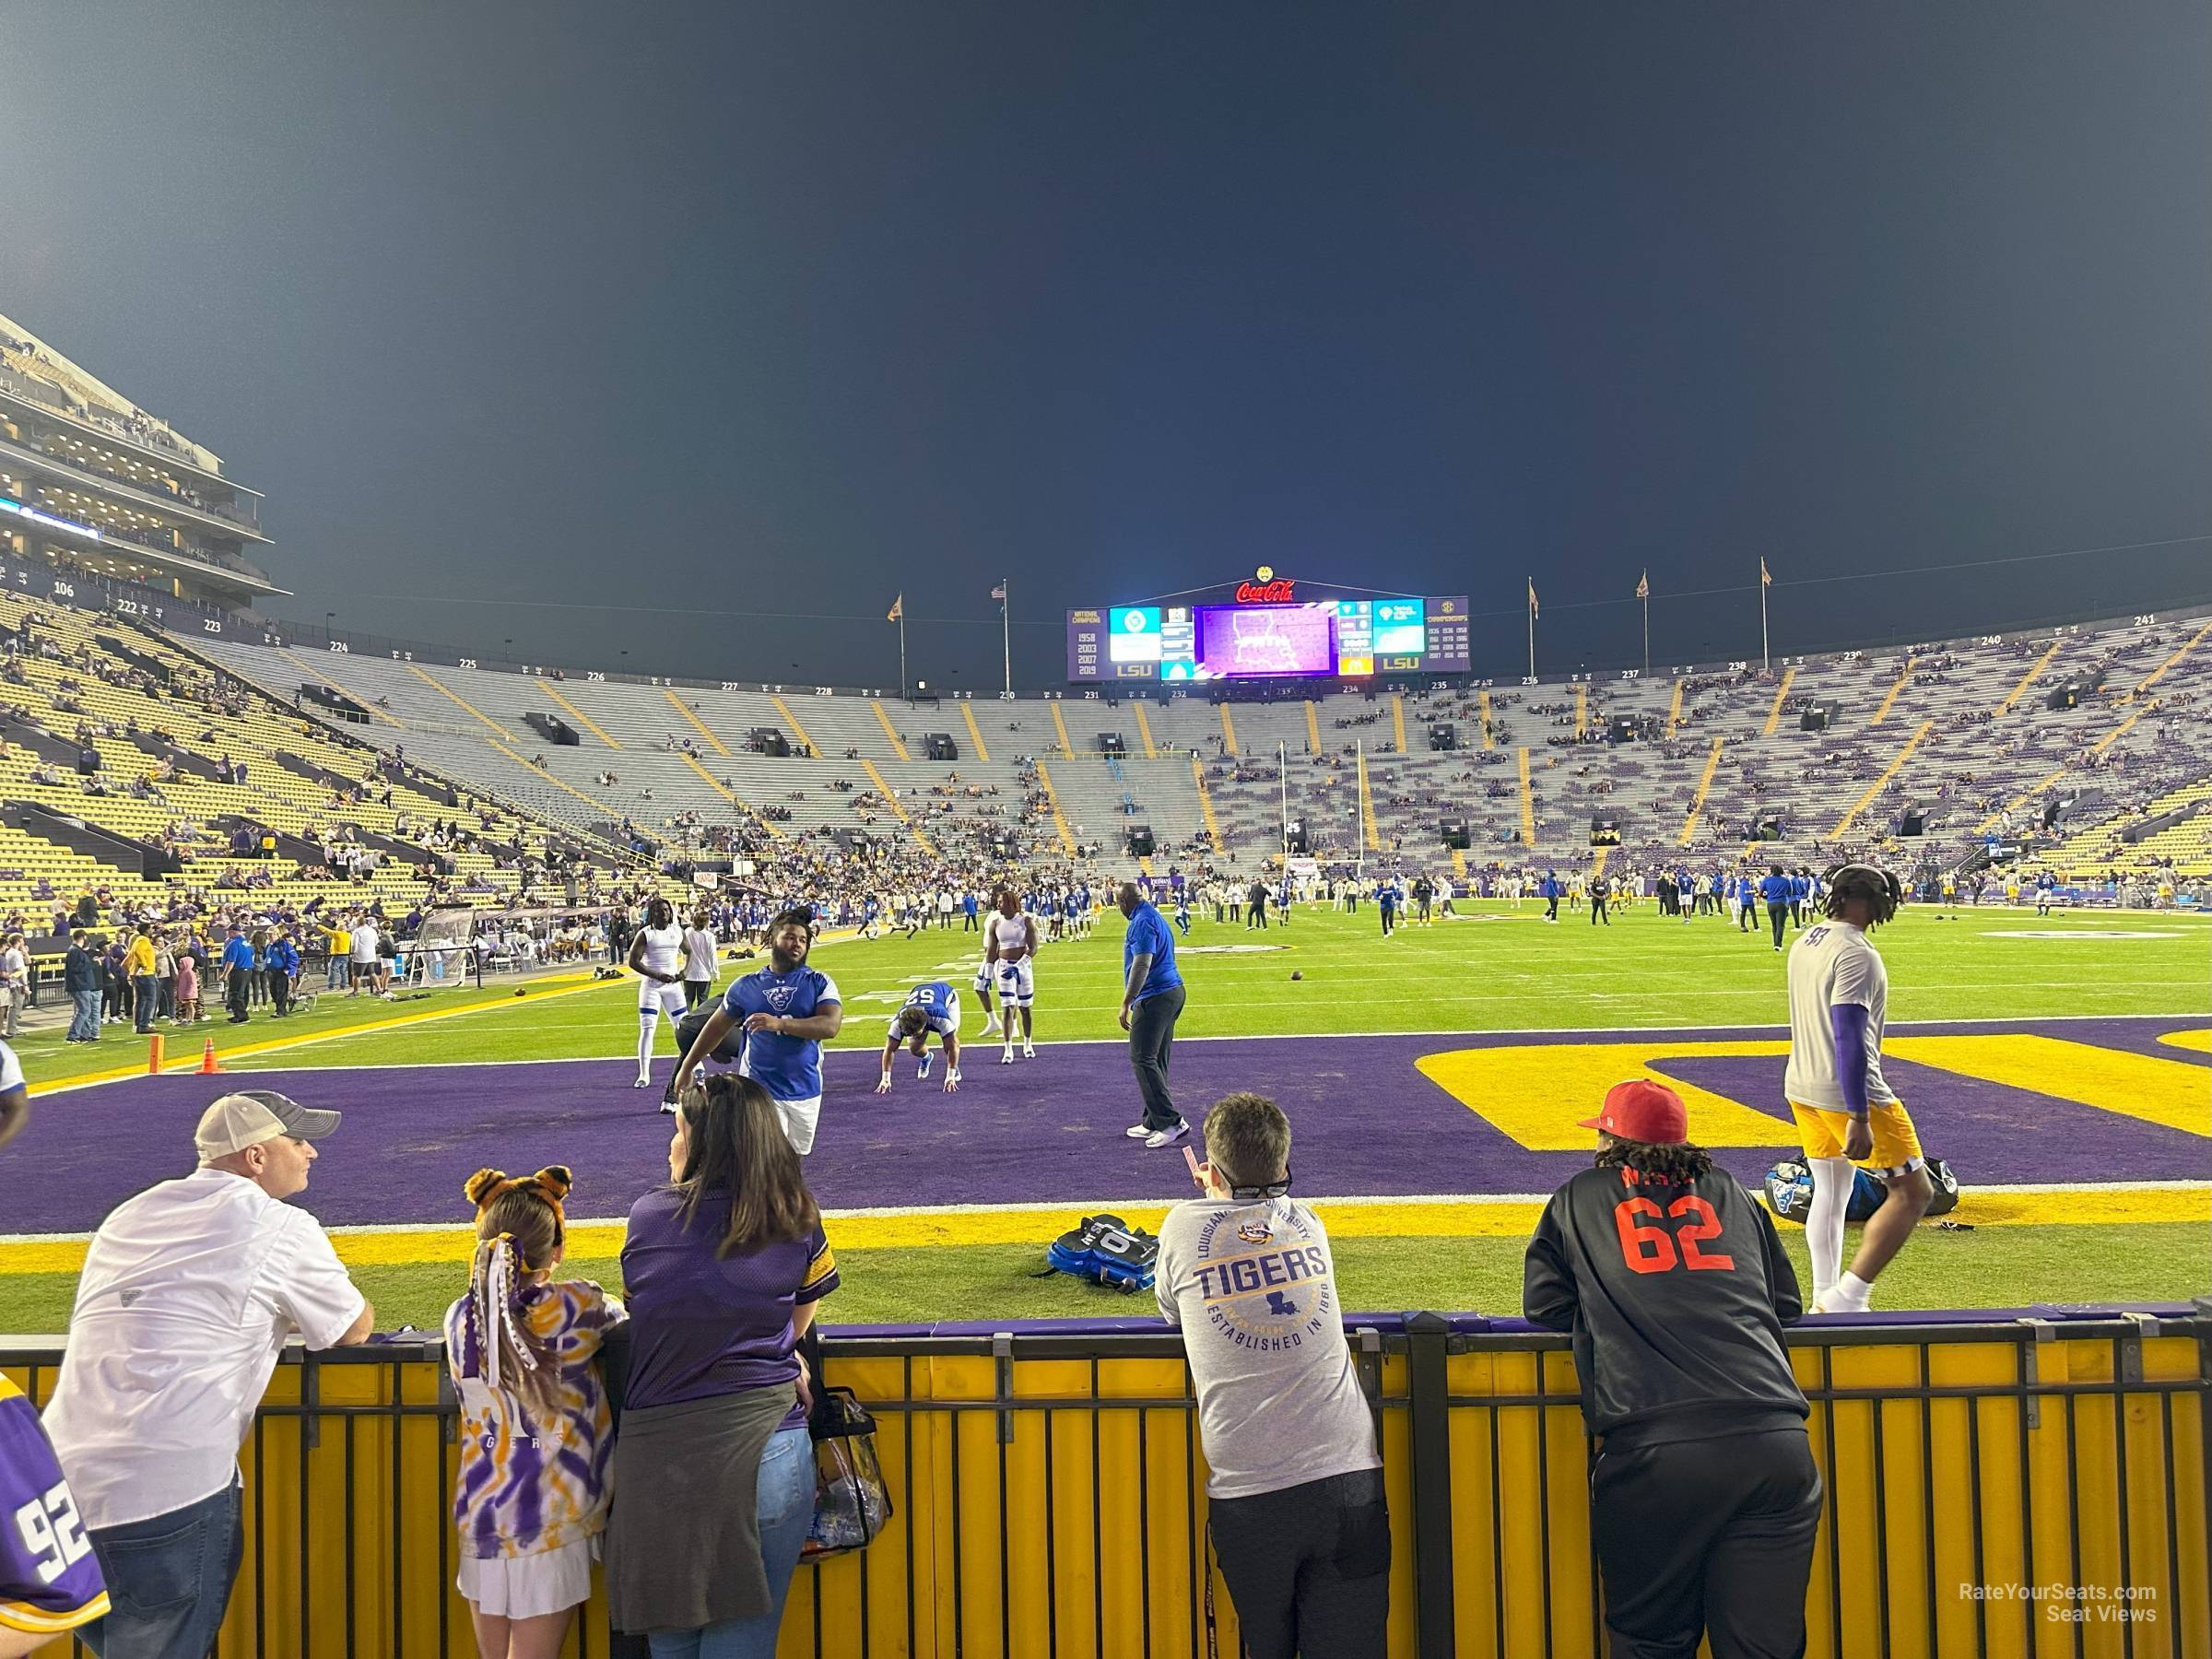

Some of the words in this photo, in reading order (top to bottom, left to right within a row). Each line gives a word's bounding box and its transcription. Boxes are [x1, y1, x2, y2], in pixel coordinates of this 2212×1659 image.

[54, 581, 75, 597] 106
[118, 599, 137, 614] 222
[2134, 615, 2155, 626] 241
[204, 619, 220, 633] 223
[1078, 633, 1095, 641] 1958
[1982, 635, 2001, 645] 240
[330, 641, 348, 653] 224
[1078, 644, 1097, 653] 2003
[459, 659, 477, 669] 225
[1078, 655, 1097, 664] 2007
[1383, 657, 1419, 670] LSU
[1079, 665, 1096, 675] 2019
[1117, 665, 1152, 677] LSU
[1729, 662, 1747, 671] 238
[587, 672, 605, 682] 226
[1622, 670, 1639, 679] 237
[722, 681, 738, 691] 227
[1431, 681, 1447, 689] 235
[1522, 677, 1538, 686] 236
[816, 687, 832, 697] 228
[1342, 685, 1359, 693] 234
[1085, 691, 1100, 700] 231
[1171, 690, 1186, 699] 232
[1805, 927, 1831, 947] 93
[1615, 1194, 1735, 1275] 62
[1193, 1246, 1326, 1300] TIGERS
[1207, 1305, 1301, 1351] ESTABLISHED
[1307, 1318, 1322, 1335] IN
[1319, 1284, 1330, 1314] 1860
[16, 1478, 92, 1583] 92
